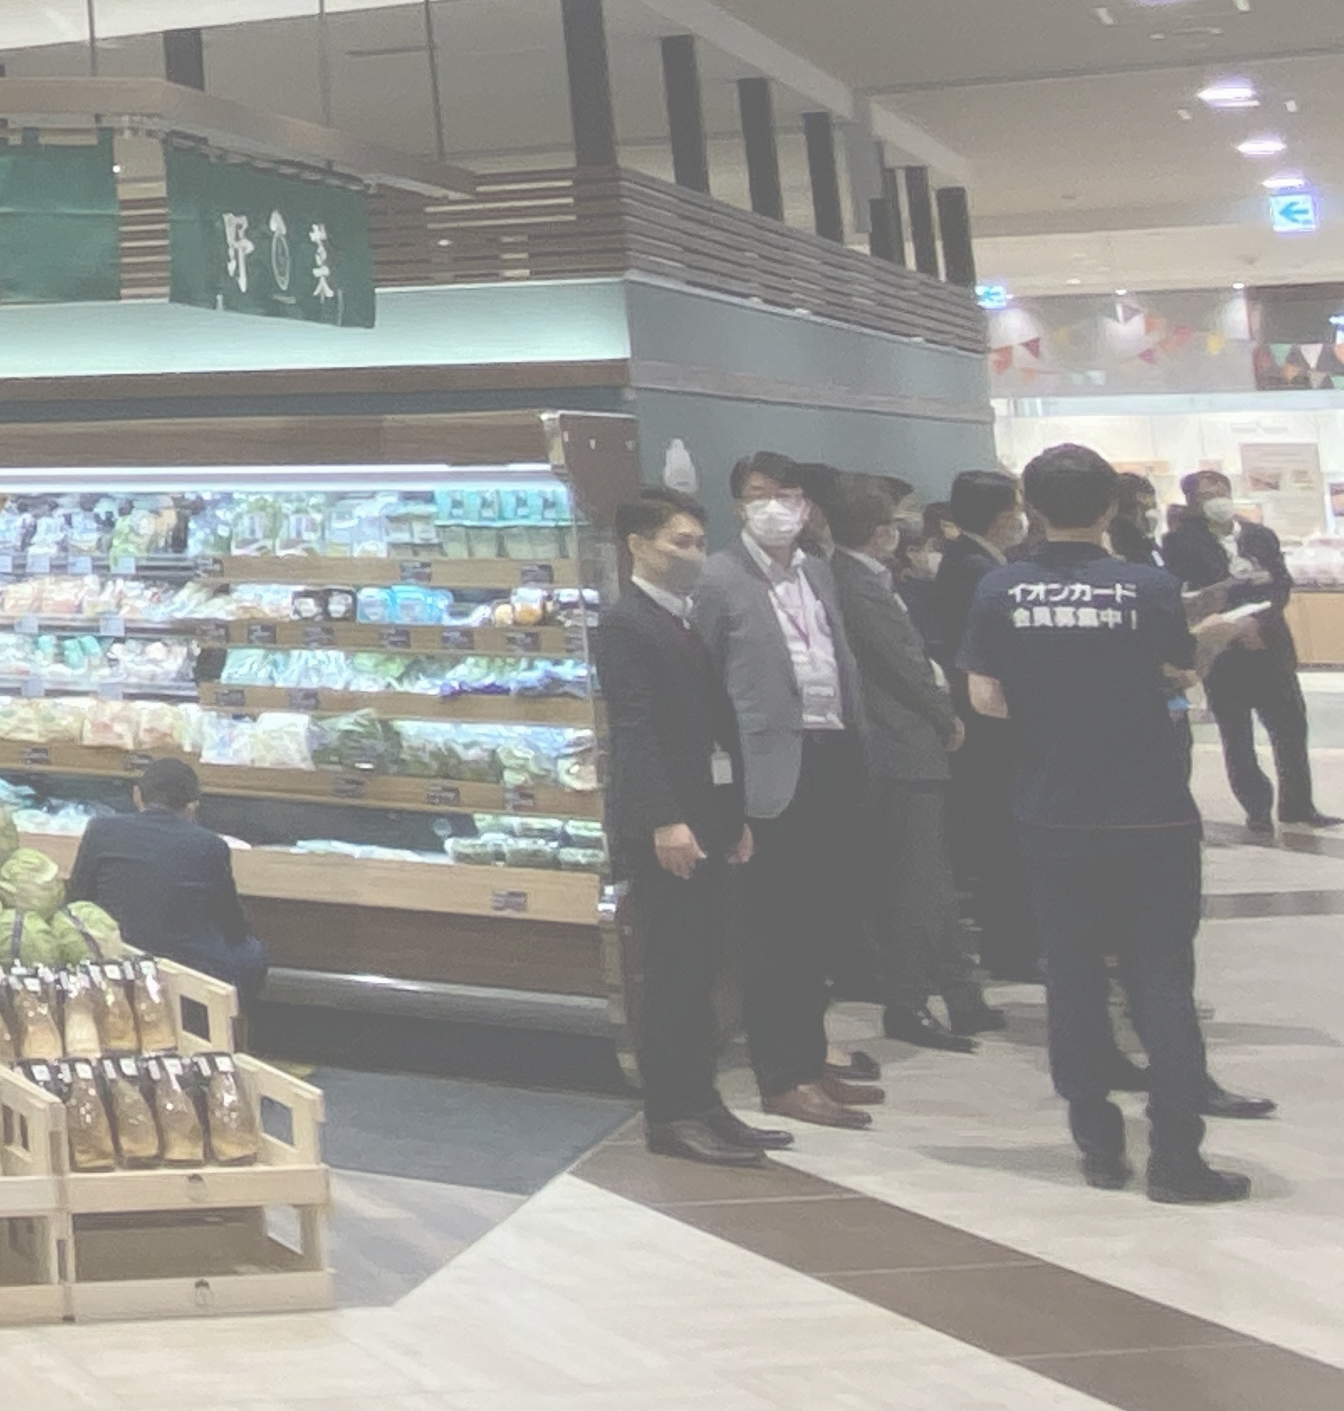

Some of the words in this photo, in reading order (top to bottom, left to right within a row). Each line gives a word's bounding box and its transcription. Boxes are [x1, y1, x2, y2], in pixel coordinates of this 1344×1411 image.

[1008, 582, 1137, 603] イオンカード
